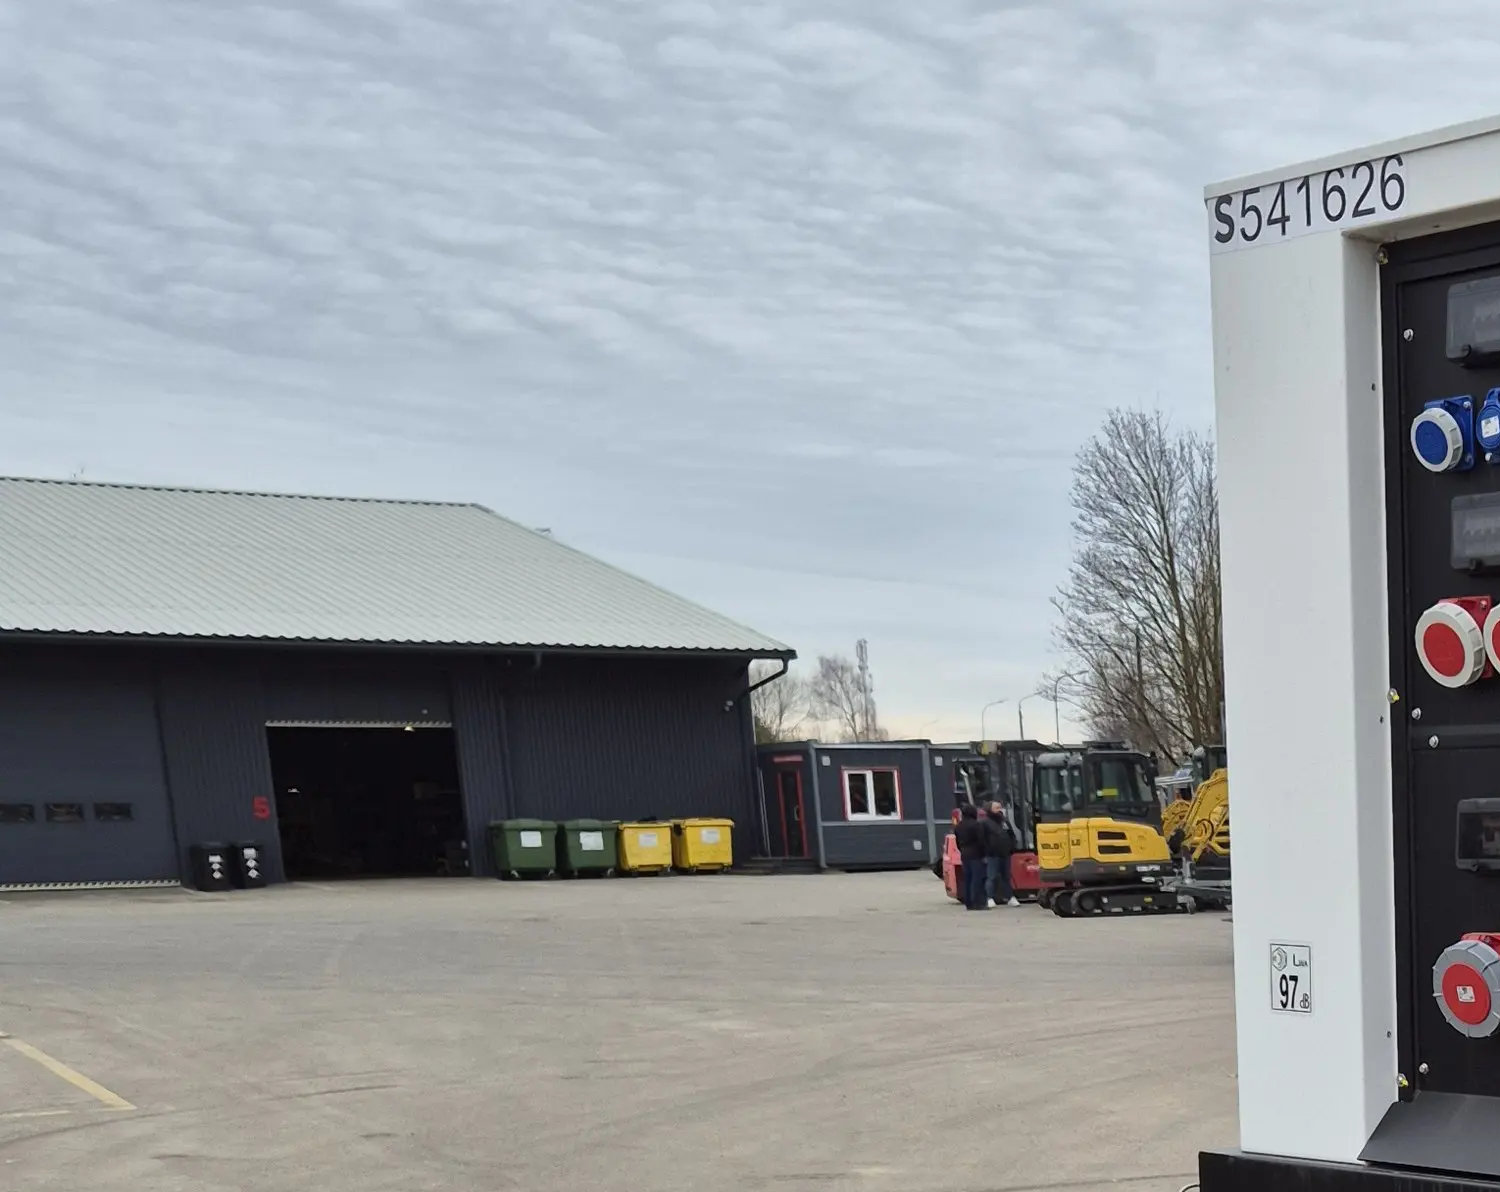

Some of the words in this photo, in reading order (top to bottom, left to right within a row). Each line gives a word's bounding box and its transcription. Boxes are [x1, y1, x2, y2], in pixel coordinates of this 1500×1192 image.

[1214, 154, 1405, 243] S541626
[253, 796, 270, 819] 5
[1279, 973, 1299, 1009] 97
